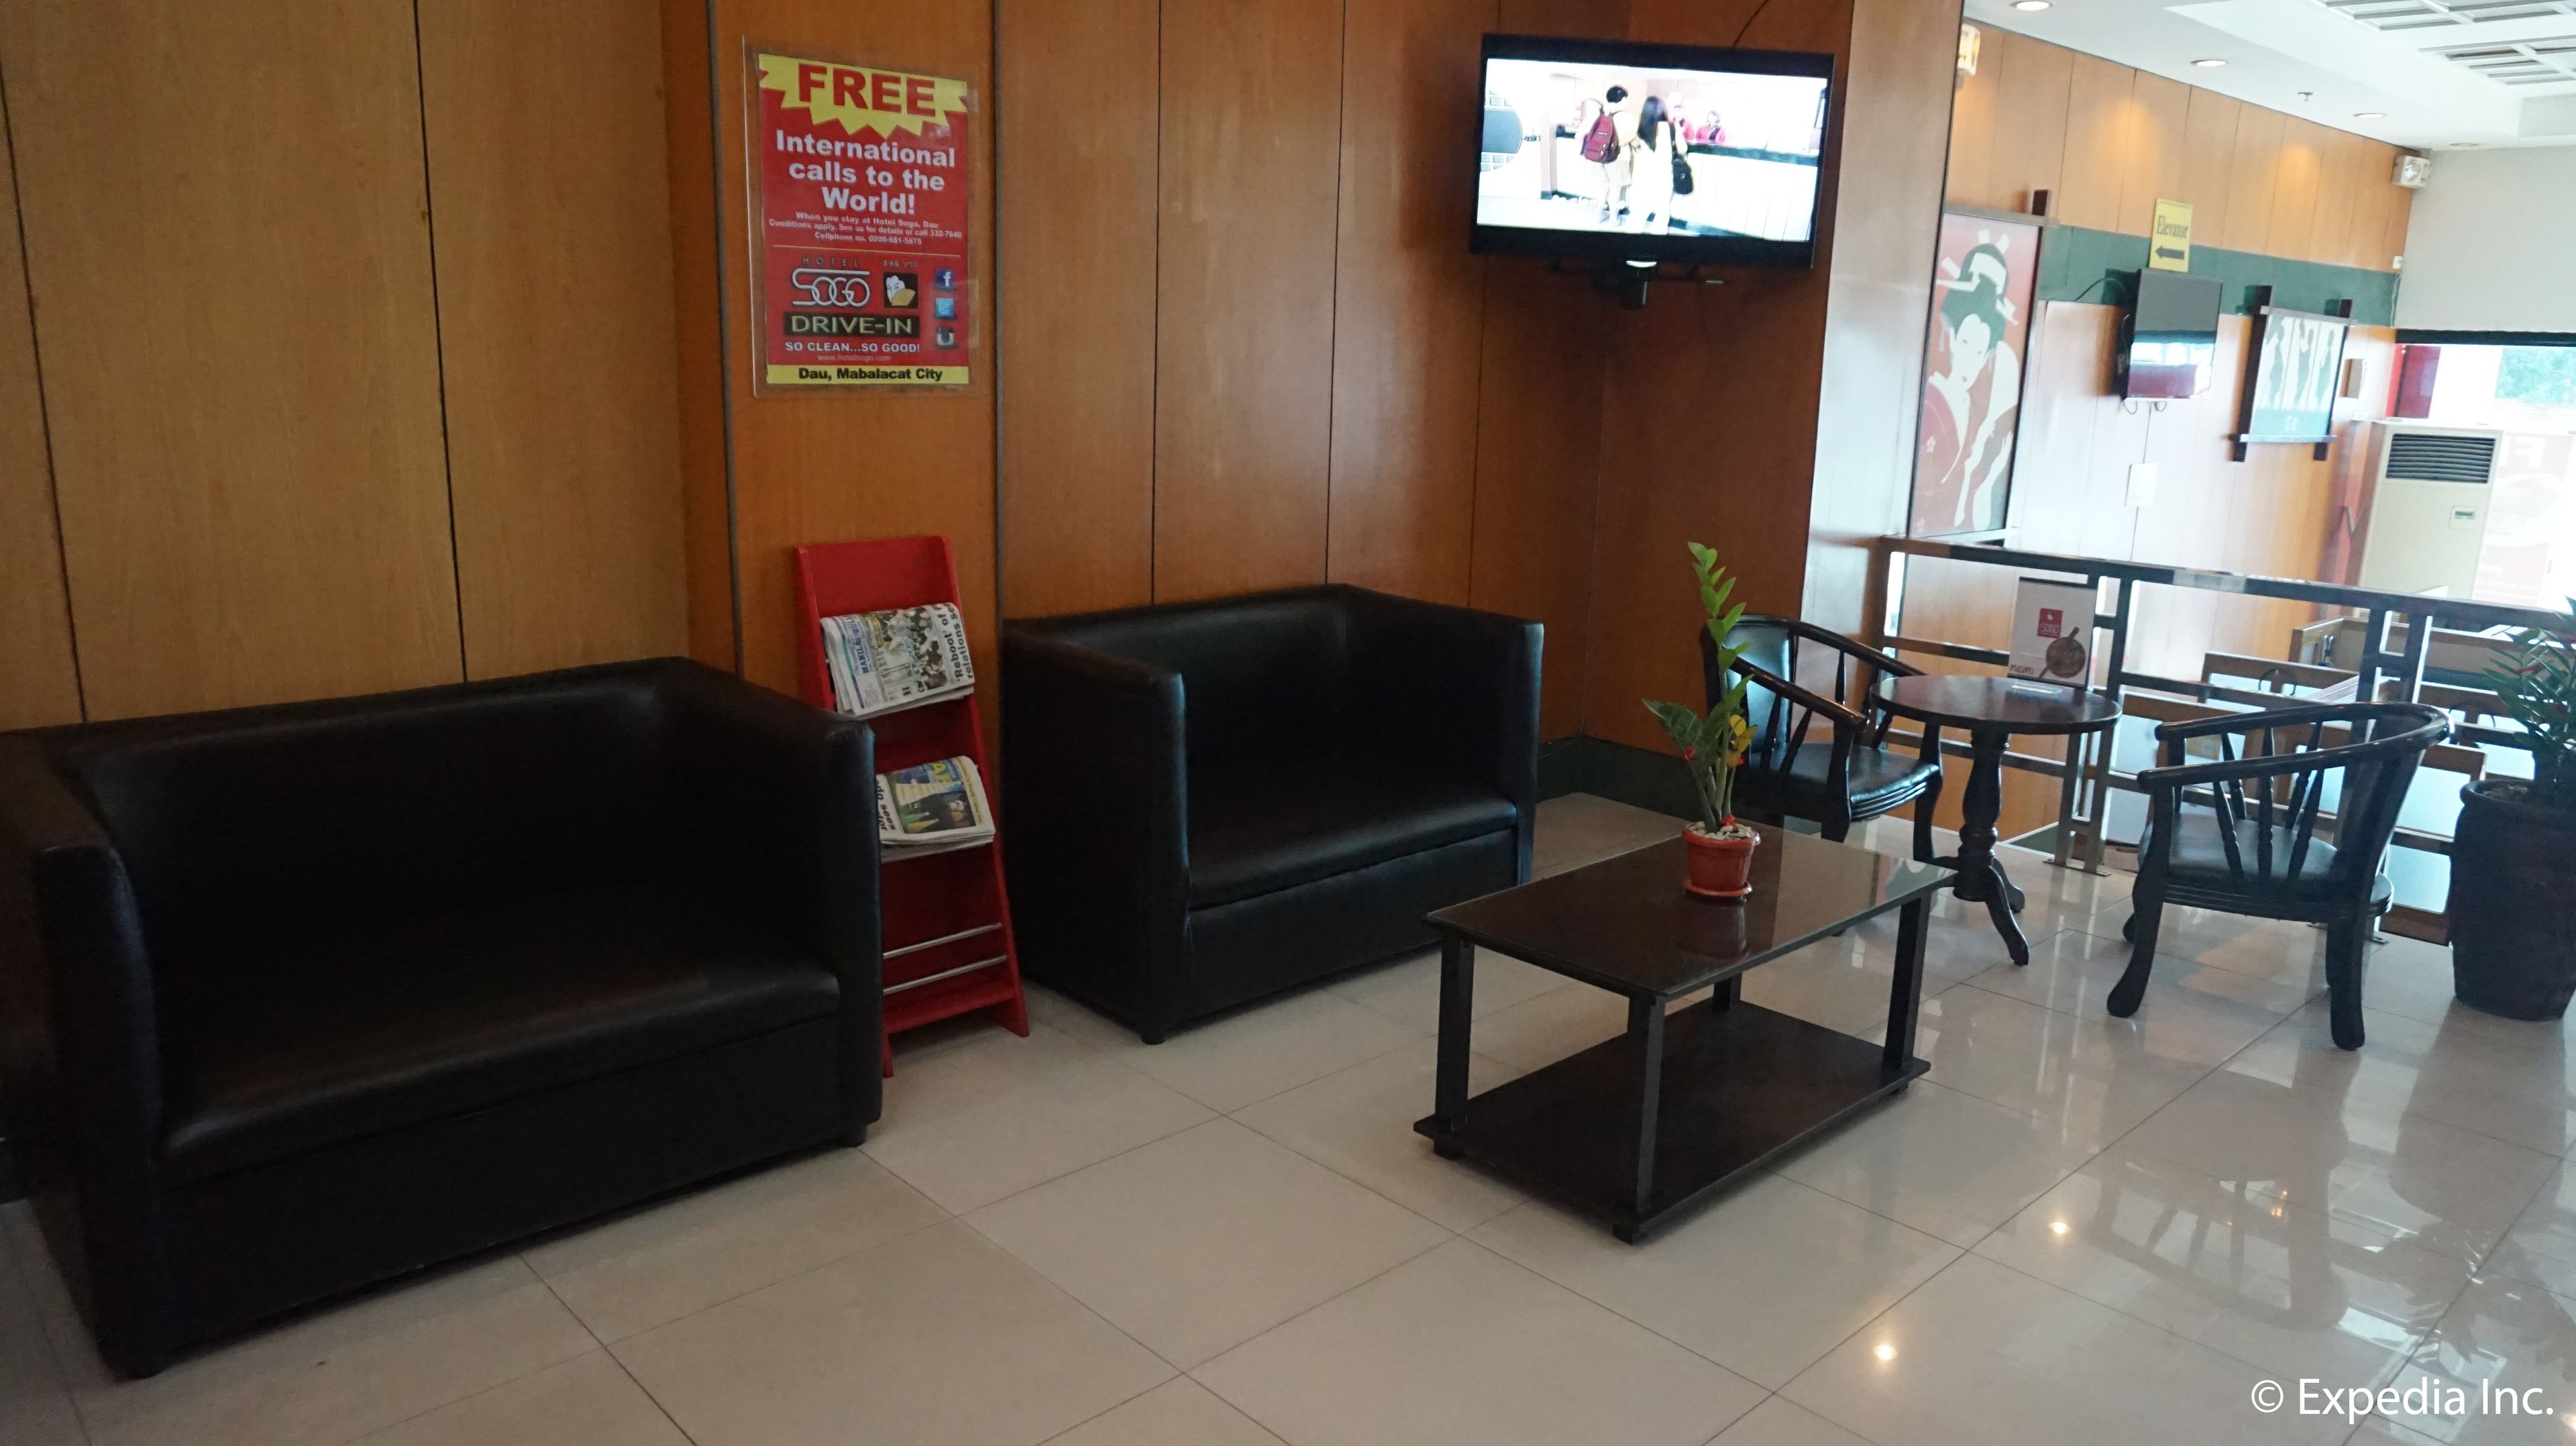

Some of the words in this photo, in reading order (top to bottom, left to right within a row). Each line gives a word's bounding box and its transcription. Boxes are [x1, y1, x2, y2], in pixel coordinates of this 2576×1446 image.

[798, 62, 936, 117] FREE
[775, 129, 955, 168] International
[789, 161, 857, 183] calls
[866, 166, 893, 187] to
[902, 169, 945, 191] the
[821, 186, 915, 215] World!
[769, 219, 812, 228] Conditions
[839, 223, 853, 231] See
[879, 226, 903, 235] details
[796, 211, 820, 220] When
[823, 215, 838, 223] you
[841, 215, 859, 224] stay
[873, 217, 896, 225] Hotel
[923, 220, 938, 228] Dau
[2156, 215, 2188, 237] Elevator
[814, 231, 853, 241] Cellphone
[803, 257, 859, 267] HOTEL
[792, 268, 870, 307] SOGO
[791, 315, 912, 335] DRIVE-IN
[785, 341, 803, 351] SO
[881, 343, 920, 353] GOOD!
[817, 353, 892, 362] www.hotelsogo.com
[798, 368, 832, 381] Dau,
[837, 368, 912, 380] Mabalacat
[916, 368, 943, 382] City
[937, 613, 949, 626] of
[953, 622, 974, 679] relations
